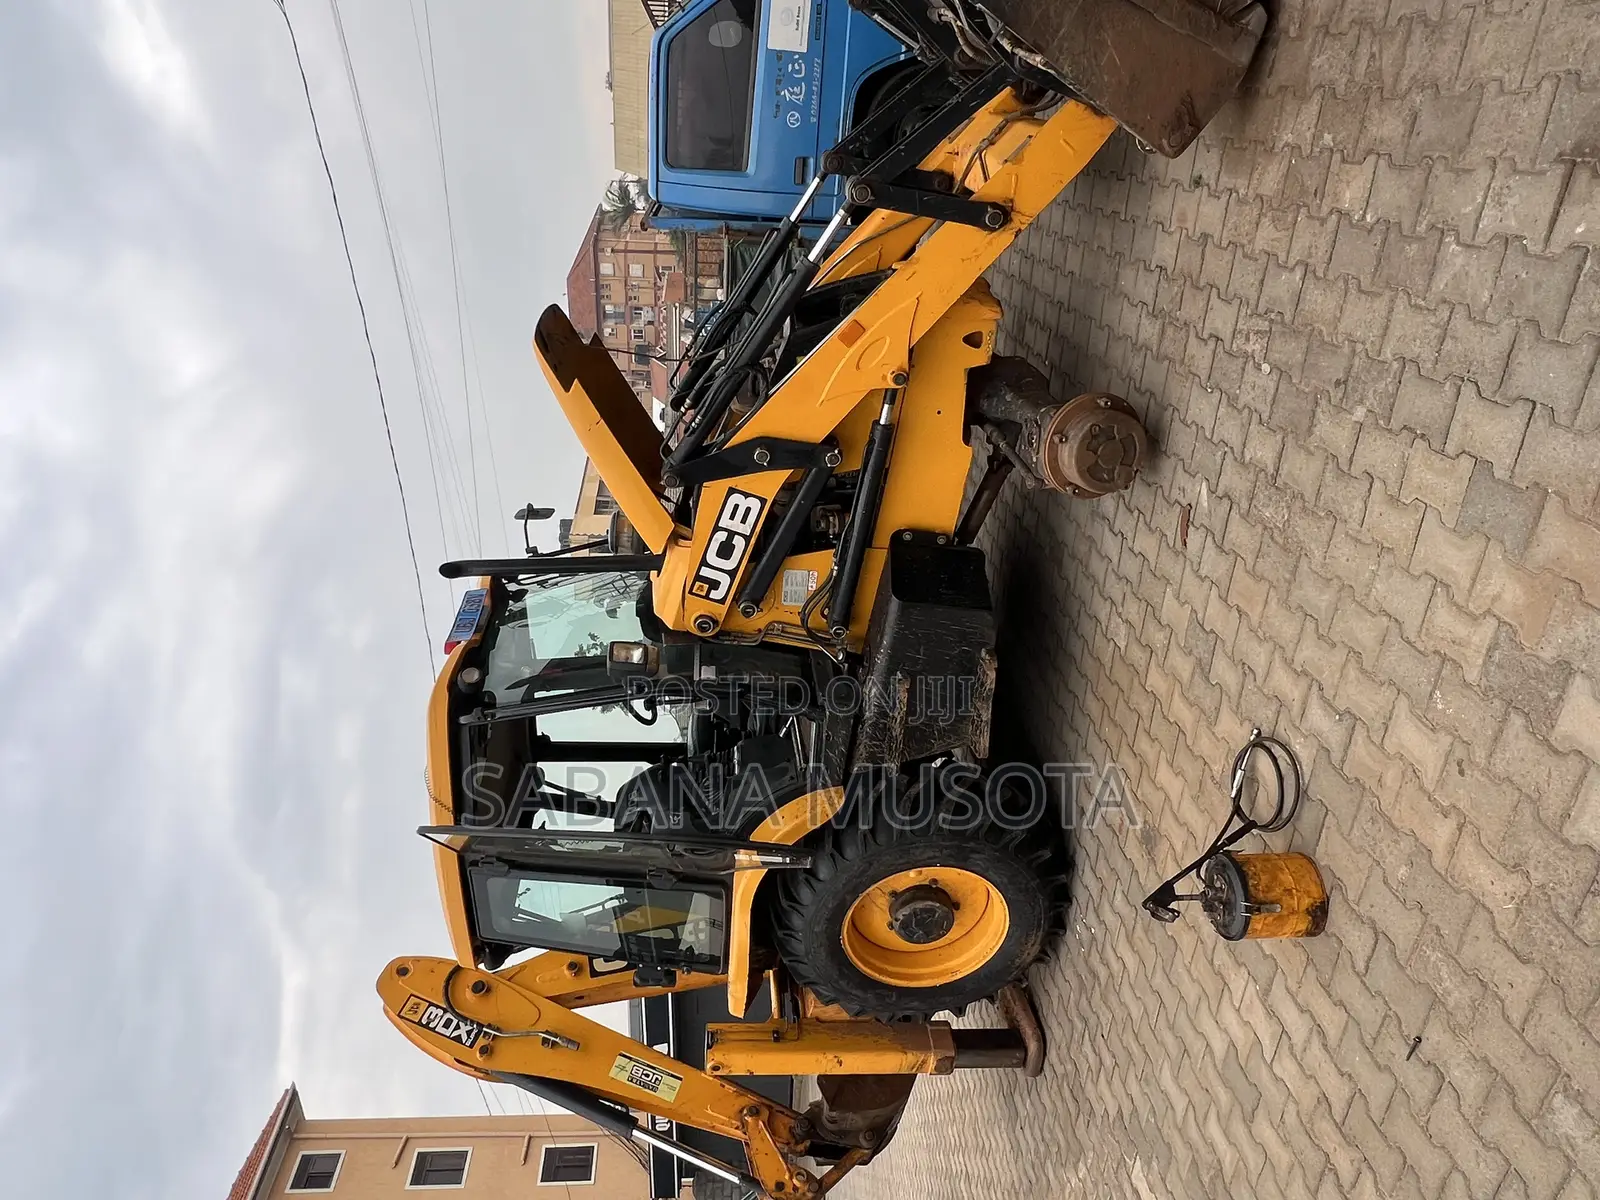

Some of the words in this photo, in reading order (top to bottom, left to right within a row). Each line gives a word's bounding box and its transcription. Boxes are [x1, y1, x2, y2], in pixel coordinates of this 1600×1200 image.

[699, 493, 762, 600] JCB
[421, 1006, 474, 1044] 3DX
[631, 1066, 662, 1085] JCB
